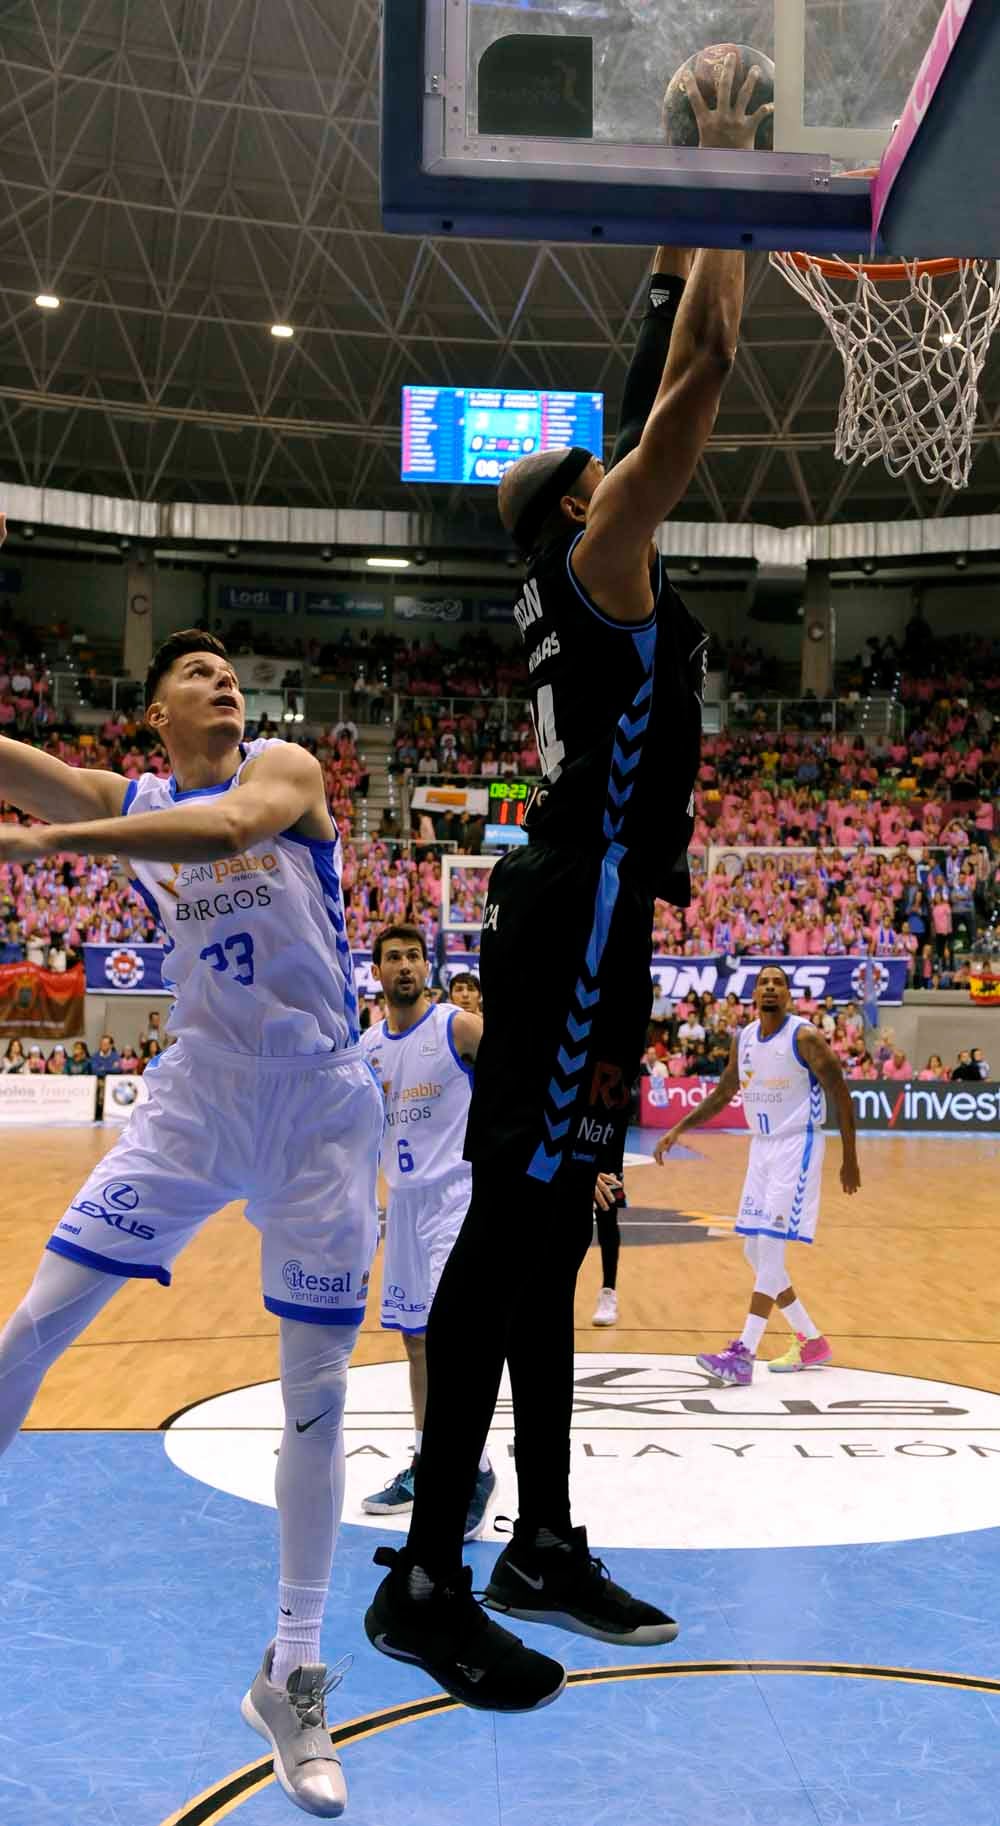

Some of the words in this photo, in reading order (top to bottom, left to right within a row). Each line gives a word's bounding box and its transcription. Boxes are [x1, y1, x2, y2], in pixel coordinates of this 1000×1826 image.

[200, 932, 255, 985] 33
[757, 1112, 770, 1135] 11
[397, 1138, 415, 1173] 6
[711, 1443, 756, 1458] Y
